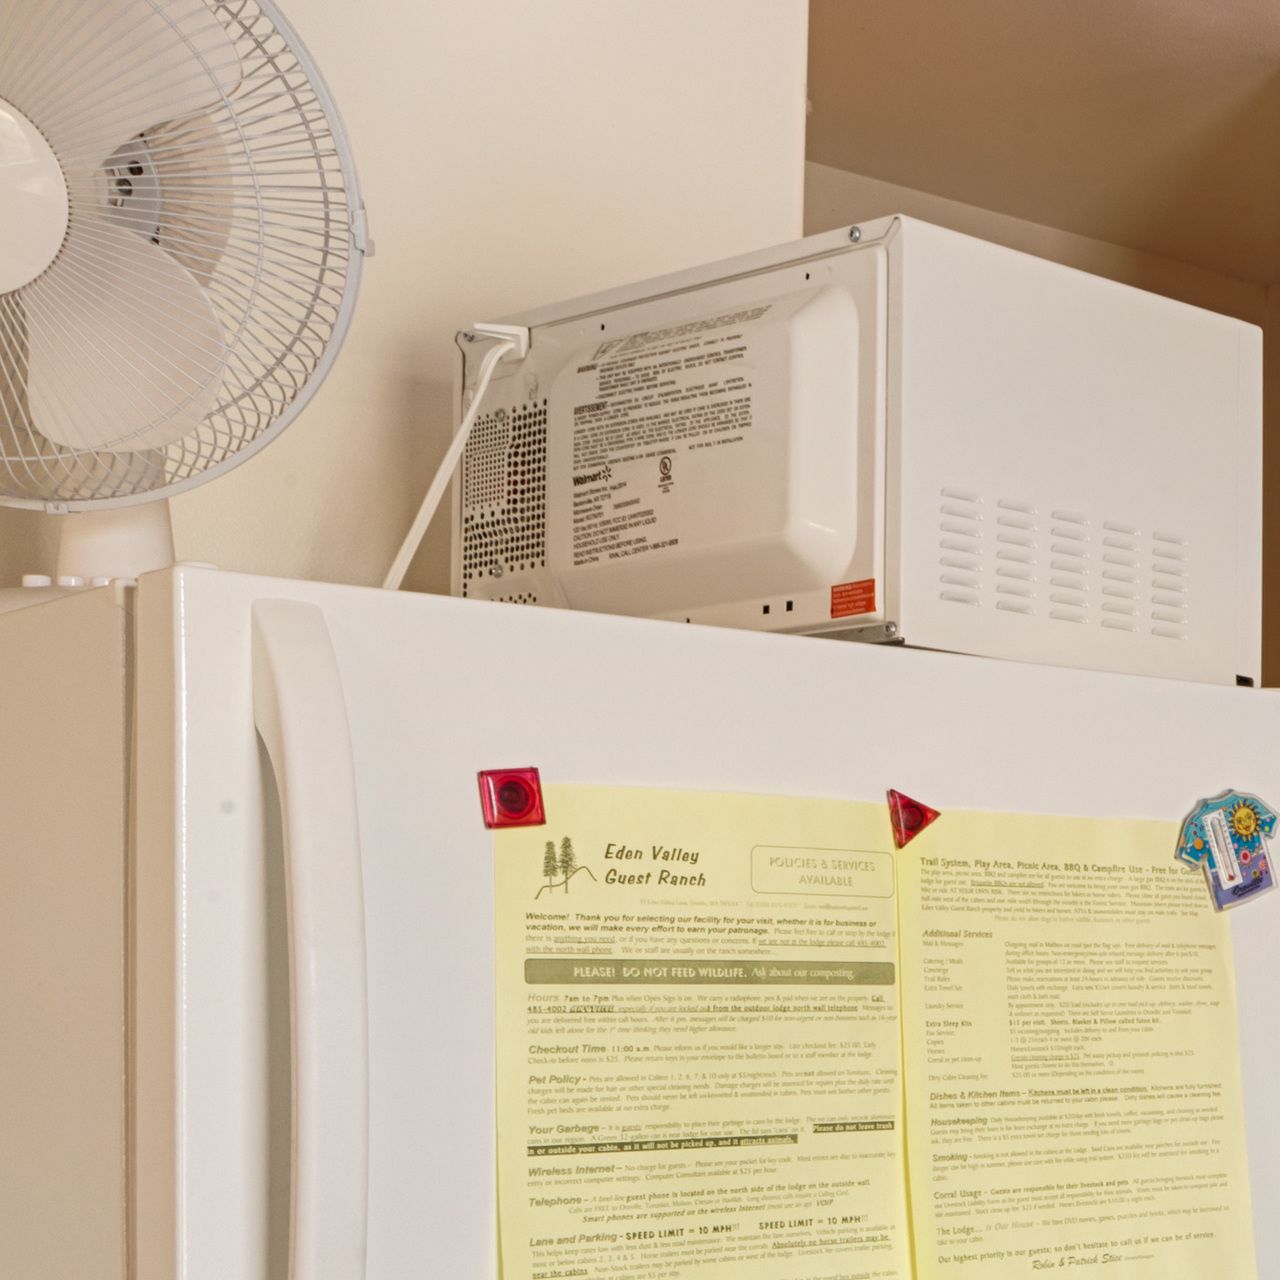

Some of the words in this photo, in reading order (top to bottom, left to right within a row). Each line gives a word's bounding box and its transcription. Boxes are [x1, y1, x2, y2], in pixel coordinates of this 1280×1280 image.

[573, 471, 602, 487] Walmart
[605, 843, 642, 860] Eden
[652, 846, 699, 864] Valley
[770, 857, 817, 869] POLICIES
[832, 860, 876, 871] SERVICES
[920, 857, 939, 866] Trail
[941, 858, 971, 869] System,
[974, 860, 991, 870] Play
[993, 860, 1014, 869] Area,
[1017, 861, 1040, 870] Picnic
[1042, 862, 1061, 872] Area,
[1064, 864, 1080, 872] BBQ
[1091, 864, 1125, 875] Campfire
[1151, 866, 1167, 874] Free
[605, 869, 651, 884] Guest
[658, 870, 706, 886] Ranch
[799, 875, 853, 887] AVAILABLE
[526, 912, 570, 921] Welcome!
[637, 915, 675, 924] selecting
[694, 916, 720, 925] facility
[723, 916, 735, 924] for
[526, 923, 566, 932] vacation,
[728, 927, 768, 935] patronage.
[922, 930, 962, 938] Additional
[963, 930, 993, 938] Services
[574, 967, 616, 977] PLEASE!
[623, 967, 640, 977] DO
[644, 967, 667, 977] NOT
[672, 967, 695, 977] FEED
[700, 968, 747, 978] WILDLIFE.
[751, 968, 766, 977] Ask
[769, 968, 792, 977] about
[528, 994, 559, 1002] Hours
[593, 995, 609, 1003] 7pm
[529, 1045, 578, 1054] Checkout
[582, 1045, 606, 1053] Time
[529, 1075, 546, 1084] Pet
[550, 1075, 581, 1086] Policy
[930, 1092, 958, 1101] Dishes
[960, 1091, 966, 1100] &
[968, 1090, 997, 1099] Kitchen
[1000, 1090, 1020, 1098] Items
[931, 1117, 988, 1127] Housekeeping
[529, 1125, 554, 1134] Your
[556, 1124, 599, 1134] Garbage
[932, 1153, 968, 1162] Smoking
[528, 1167, 572, 1177] Wireless
[576, 1165, 615, 1174] Internet
[627, 1194, 646, 1202] guest
[649, 1193, 670, 1202] phone
[680, 1189, 704, 1197] located
[788, 1183, 806, 1192] lodge
[831, 1180, 857, 1188] outside
[934, 1190, 958, 1200] Corral
[960, 1189, 982, 1199] Usage
[529, 1198, 582, 1207] Telephone
[759, 1222, 786, 1230] SPEED
[788, 1219, 813, 1228] LIMIT
[828, 1217, 838, 1225] 10
[529, 1238, 554, 1247] Lane
[556, 1236, 576, 1245] and
[579, 1232, 618, 1244] Parking
[626, 1232, 655, 1240] SPEED
[658, 1228, 684, 1238] LIMIT
[699, 1227, 708, 1235] 10
[937, 1227, 950, 1235] The
[938, 1255, 951, 1263] Our
[953, 1253, 978, 1263] highest
[980, 1251, 1005, 1261] priority
[1064, 1244, 1081, 1252] don't
[1032, 1260, 1055, 1270] Robin
[1058, 1257, 1064, 1267] &
[1068, 1254, 1098, 1267] Patrick
